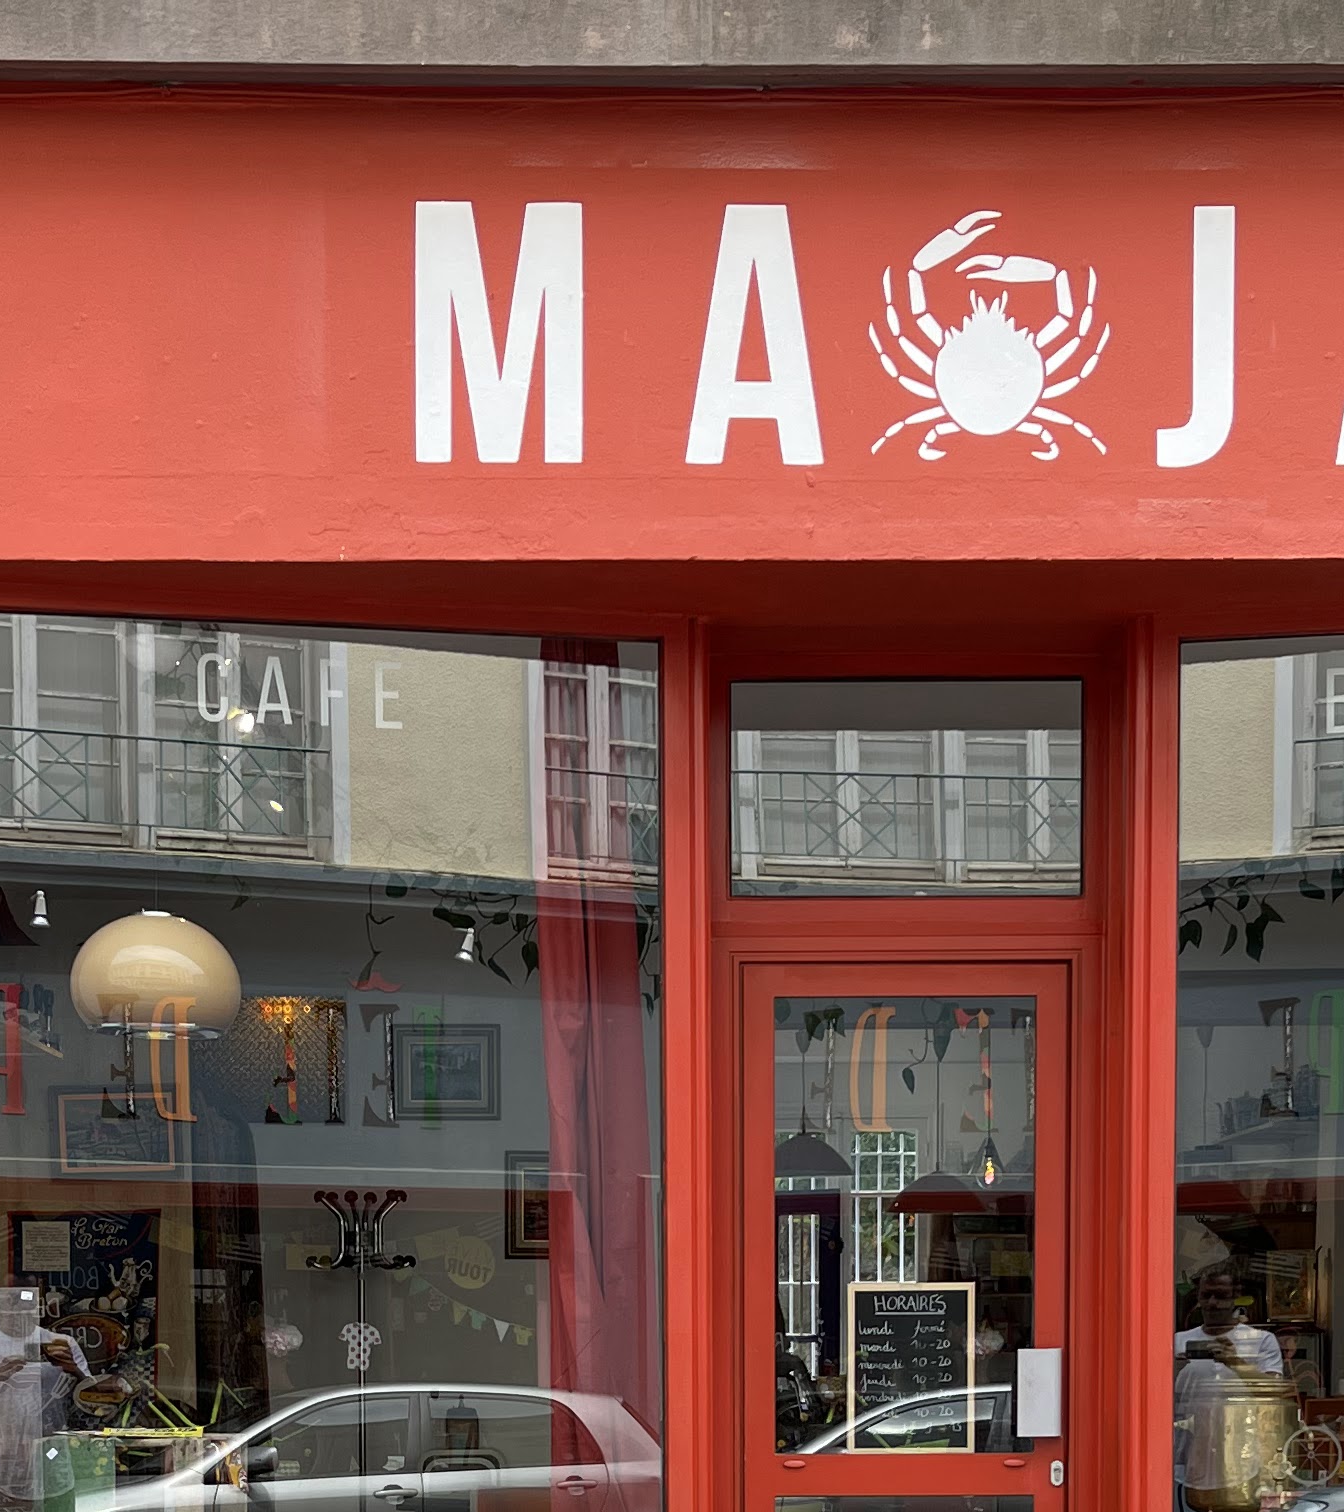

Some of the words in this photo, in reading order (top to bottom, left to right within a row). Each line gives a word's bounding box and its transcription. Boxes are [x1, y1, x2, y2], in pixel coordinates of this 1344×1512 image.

[873, 1294, 947, 1312] HORAIRES
[858, 1320, 895, 1336] lundi
[860, 1341, 897, 1353] mardi
